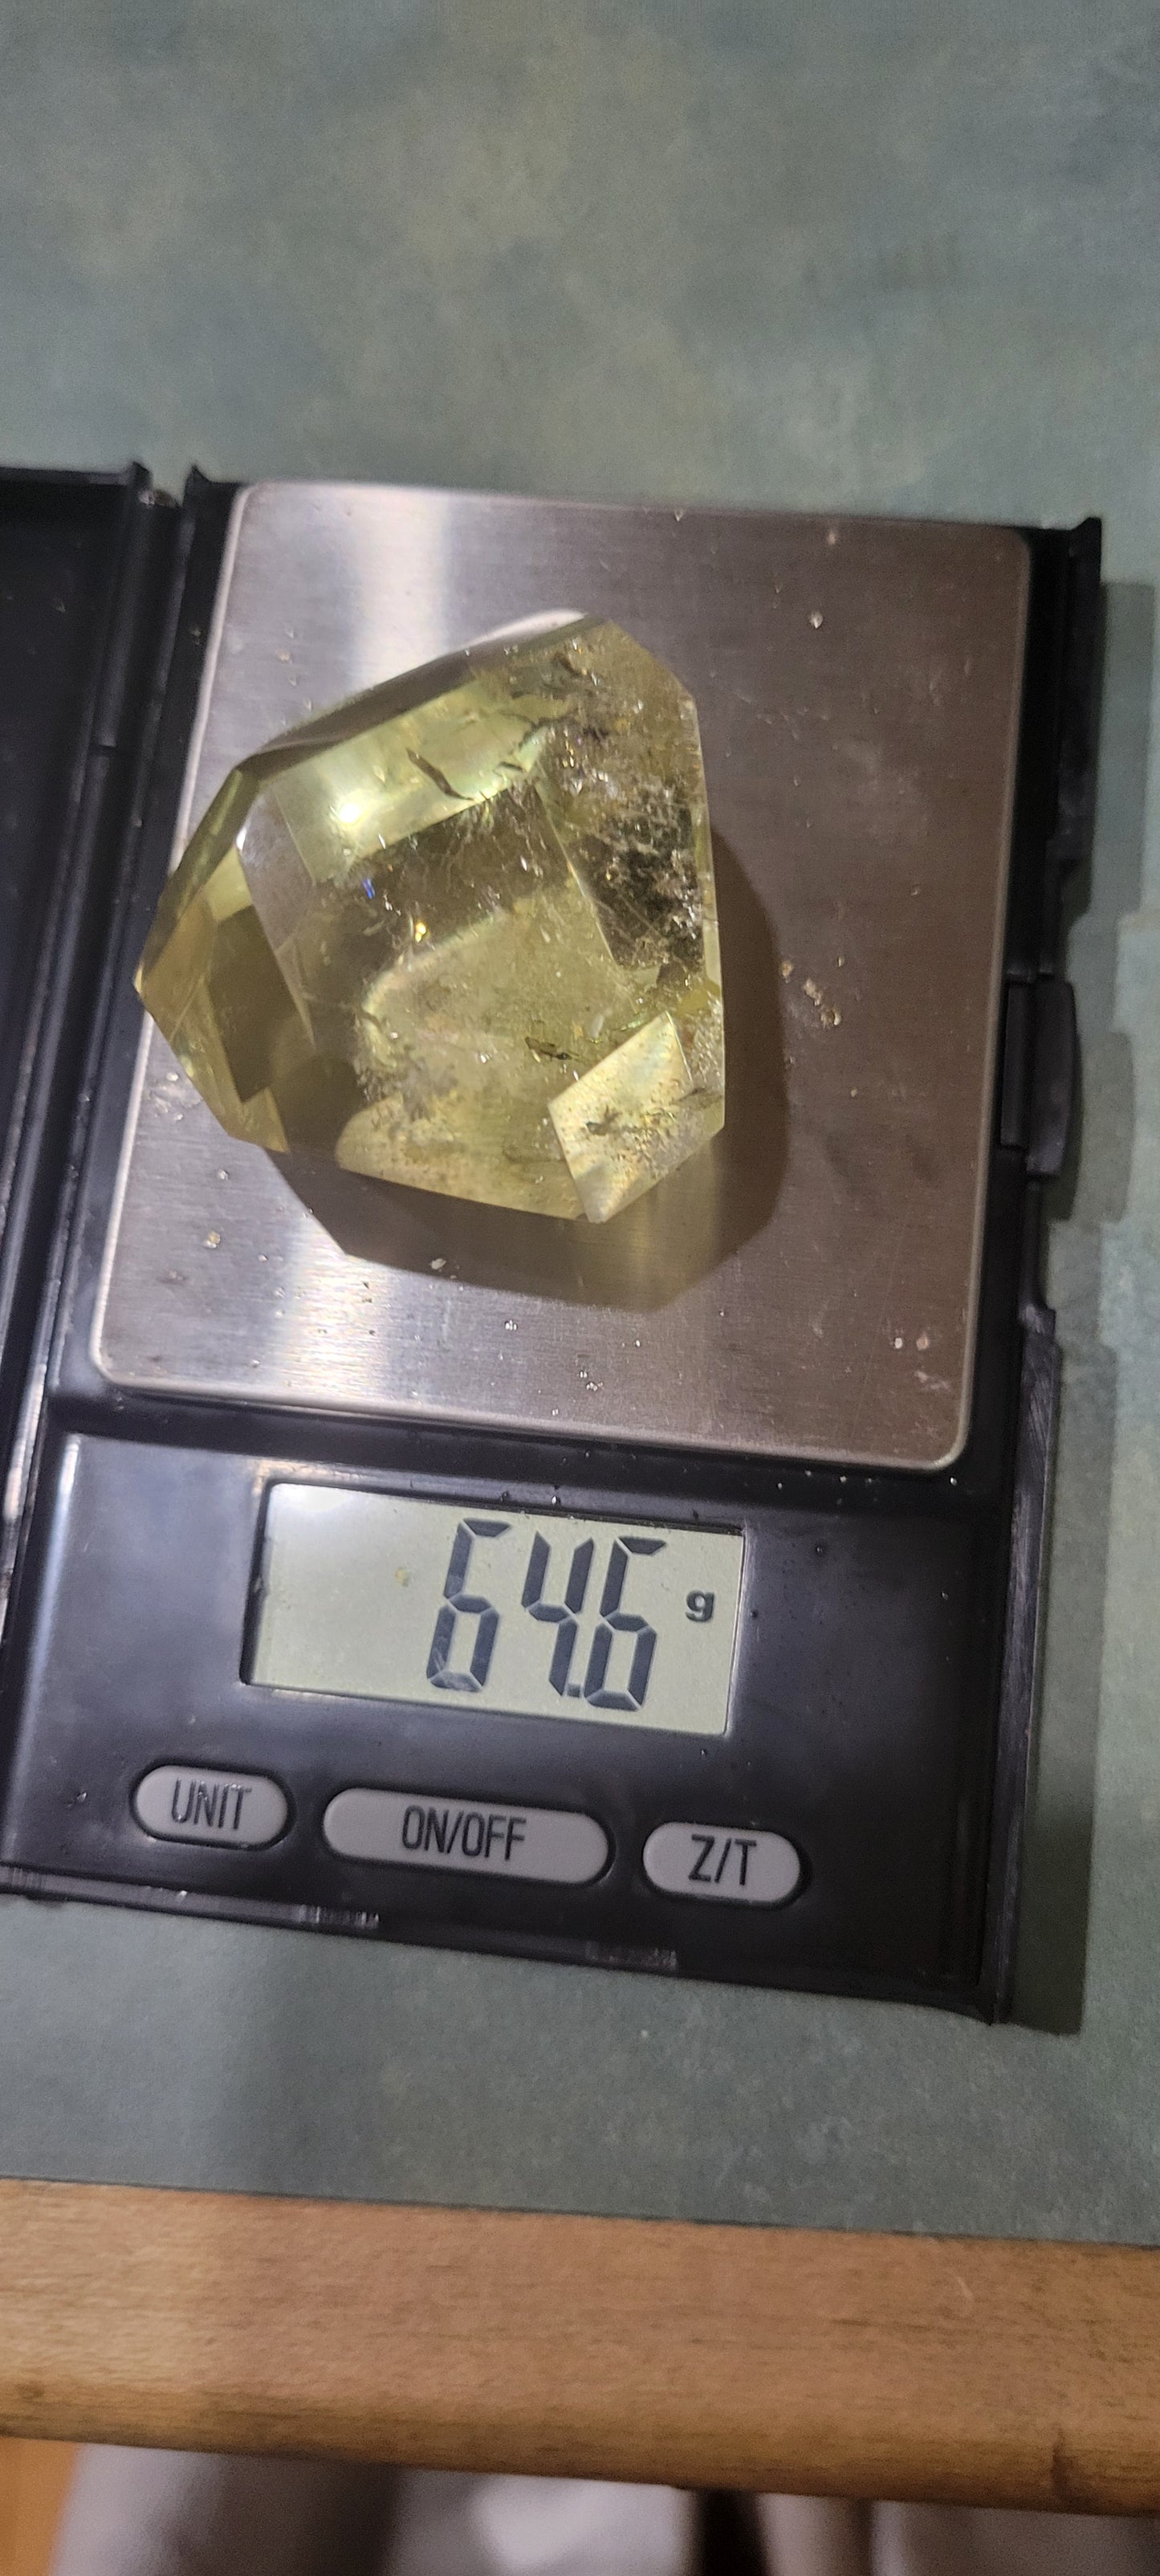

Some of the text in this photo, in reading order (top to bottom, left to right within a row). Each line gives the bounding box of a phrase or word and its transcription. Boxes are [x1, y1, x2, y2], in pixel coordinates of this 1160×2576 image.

[426, 1517, 716, 1712] 64.6 g
[170, 1777, 252, 1830] UNIT
[401, 1804, 527, 1861] ON/OFF
[688, 1832, 757, 1886] Z/T
